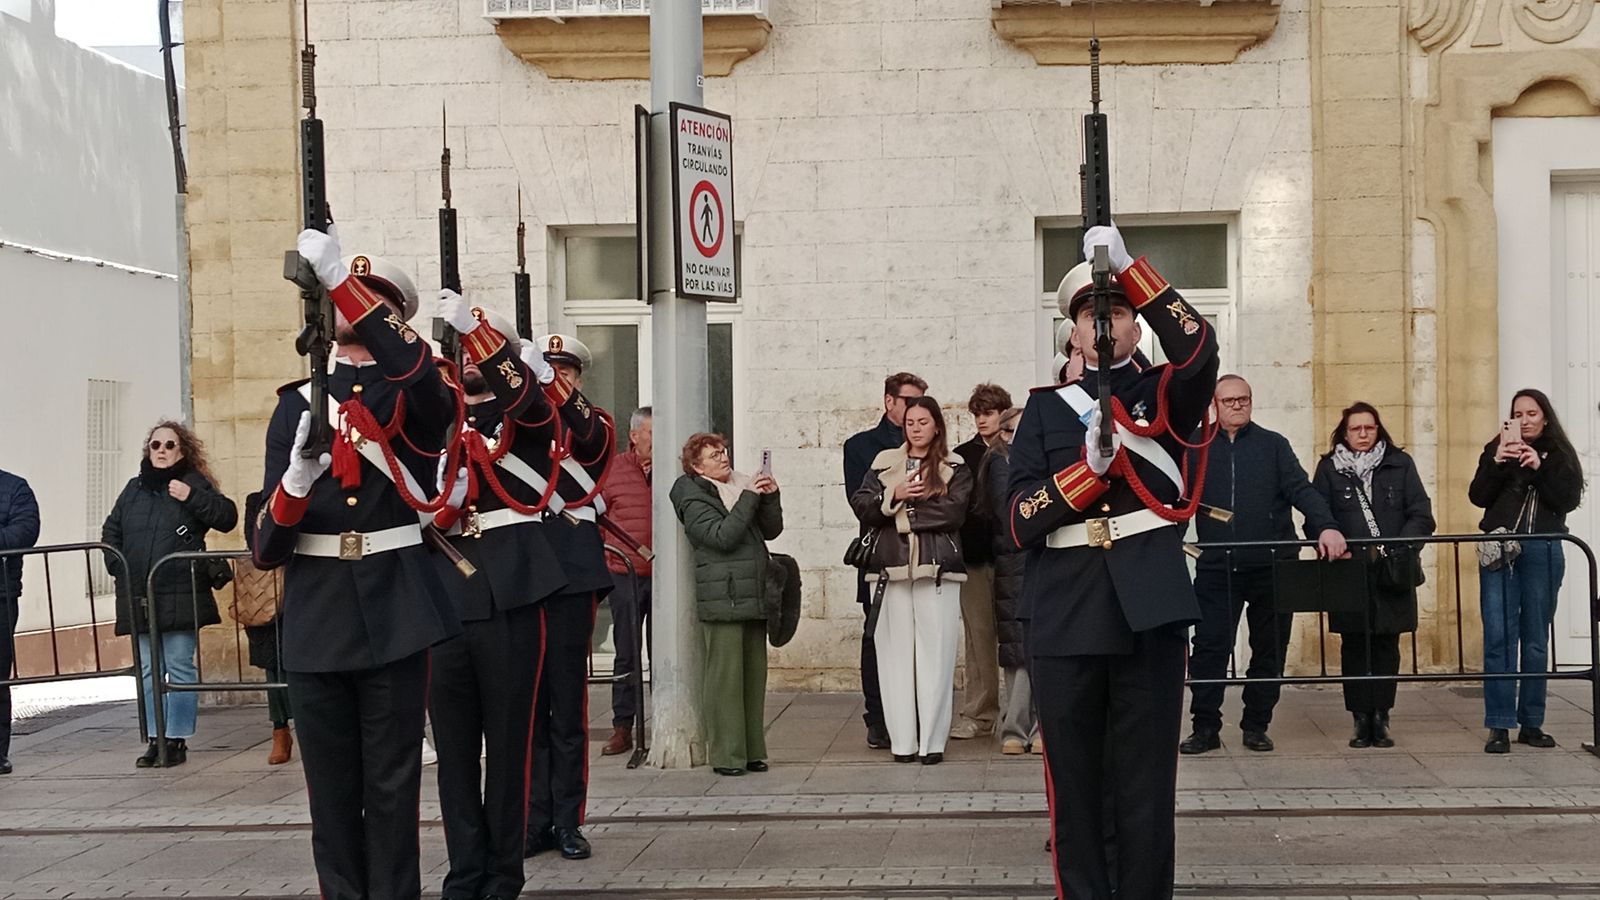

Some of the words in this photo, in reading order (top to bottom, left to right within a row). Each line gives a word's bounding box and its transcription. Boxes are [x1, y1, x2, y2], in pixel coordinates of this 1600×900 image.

[681, 119, 728, 142] ATENCIÓN
[688, 143, 722, 159] TRANVÍAS
[683, 158, 728, 177] CIRCULANDO
[685, 263, 697, 274] NO
[699, 264, 730, 277] CAMINAR
[685, 278, 699, 290] POR
[701, 281, 714, 292] LAS
[717, 280, 733, 293] VÍAS
